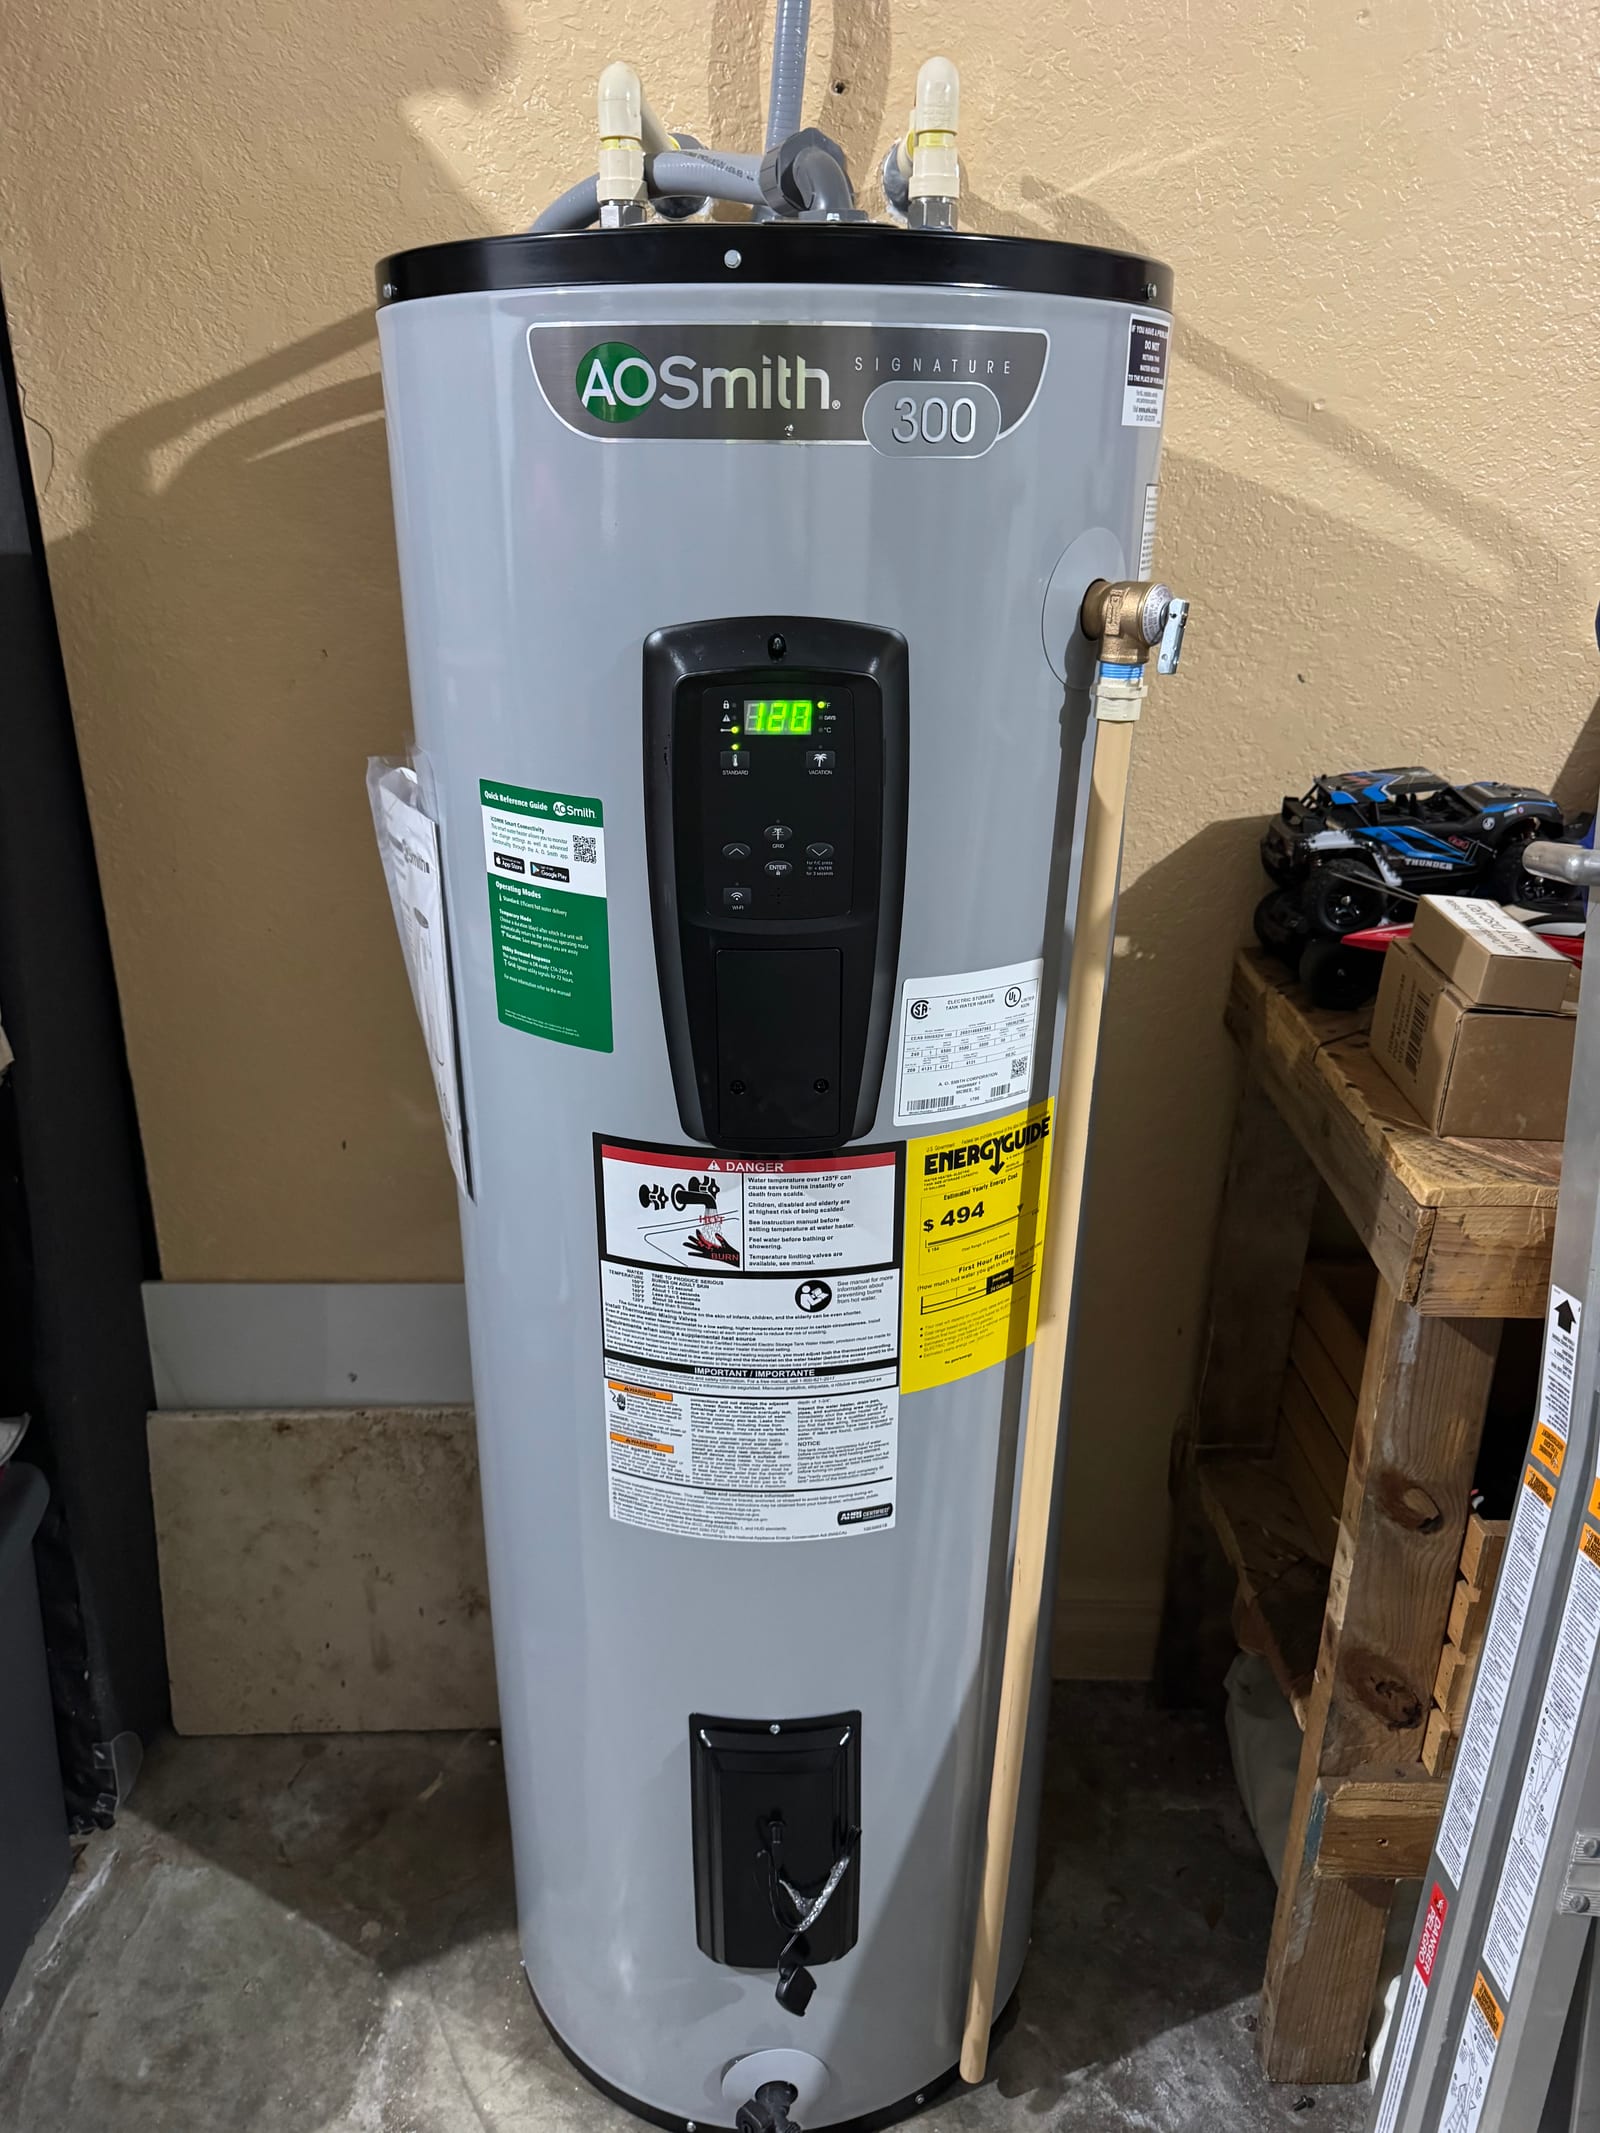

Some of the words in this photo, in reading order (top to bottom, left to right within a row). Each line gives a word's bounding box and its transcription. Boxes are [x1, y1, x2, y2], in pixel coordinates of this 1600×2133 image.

[855, 356, 1011, 375] SIGNATURE
[891, 396, 977, 443] 300
[757, 702, 810, 731] 120
[484, 790, 499, 801] Quick
[500, 795, 528, 808] Reference
[529, 801, 548, 811] Guide
[517, 823, 544, 834] Connectivity
[1404, 858, 1453, 870] THUNDER
[541, 870, 557, 878] Google
[495, 881, 521, 895] Operating
[522, 888, 542, 899] Modes
[966, 1072, 998, 1082] CORPORATION
[924, 1116, 1050, 1176] ENERGYGUIDE
[726, 1162, 784, 1172] DANGER
[944, 1188, 970, 1201] Estimated
[972, 1184, 988, 1193] Yearly
[990, 1178, 1006, 1188] Energy
[1008, 1173, 1018, 1181] Cost
[923, 1219, 934, 1232] $
[940, 1201, 985, 1226] 494
[958, 1263, 975, 1273] First
[977, 1256, 992, 1267] Hour
[994, 1248, 1014, 1260] Rating
[609, 1269, 643, 1280] TEMPERATURE
[850, 1278, 870, 1286] manual
[934, 1279, 949, 1287] much
[961, 1272, 975, 1280] water
[976, 1268, 986, 1276] you
[987, 1264, 995, 1272] get
[658, 1312, 677, 1321] Mixing
[694, 1367, 748, 1377] IMPORTANT
[755, 1369, 815, 1378] IMPORTANTE
[1418, 1905, 1436, 1964] PELIGRO
[1423, 1916, 1441, 1975] DANGER
